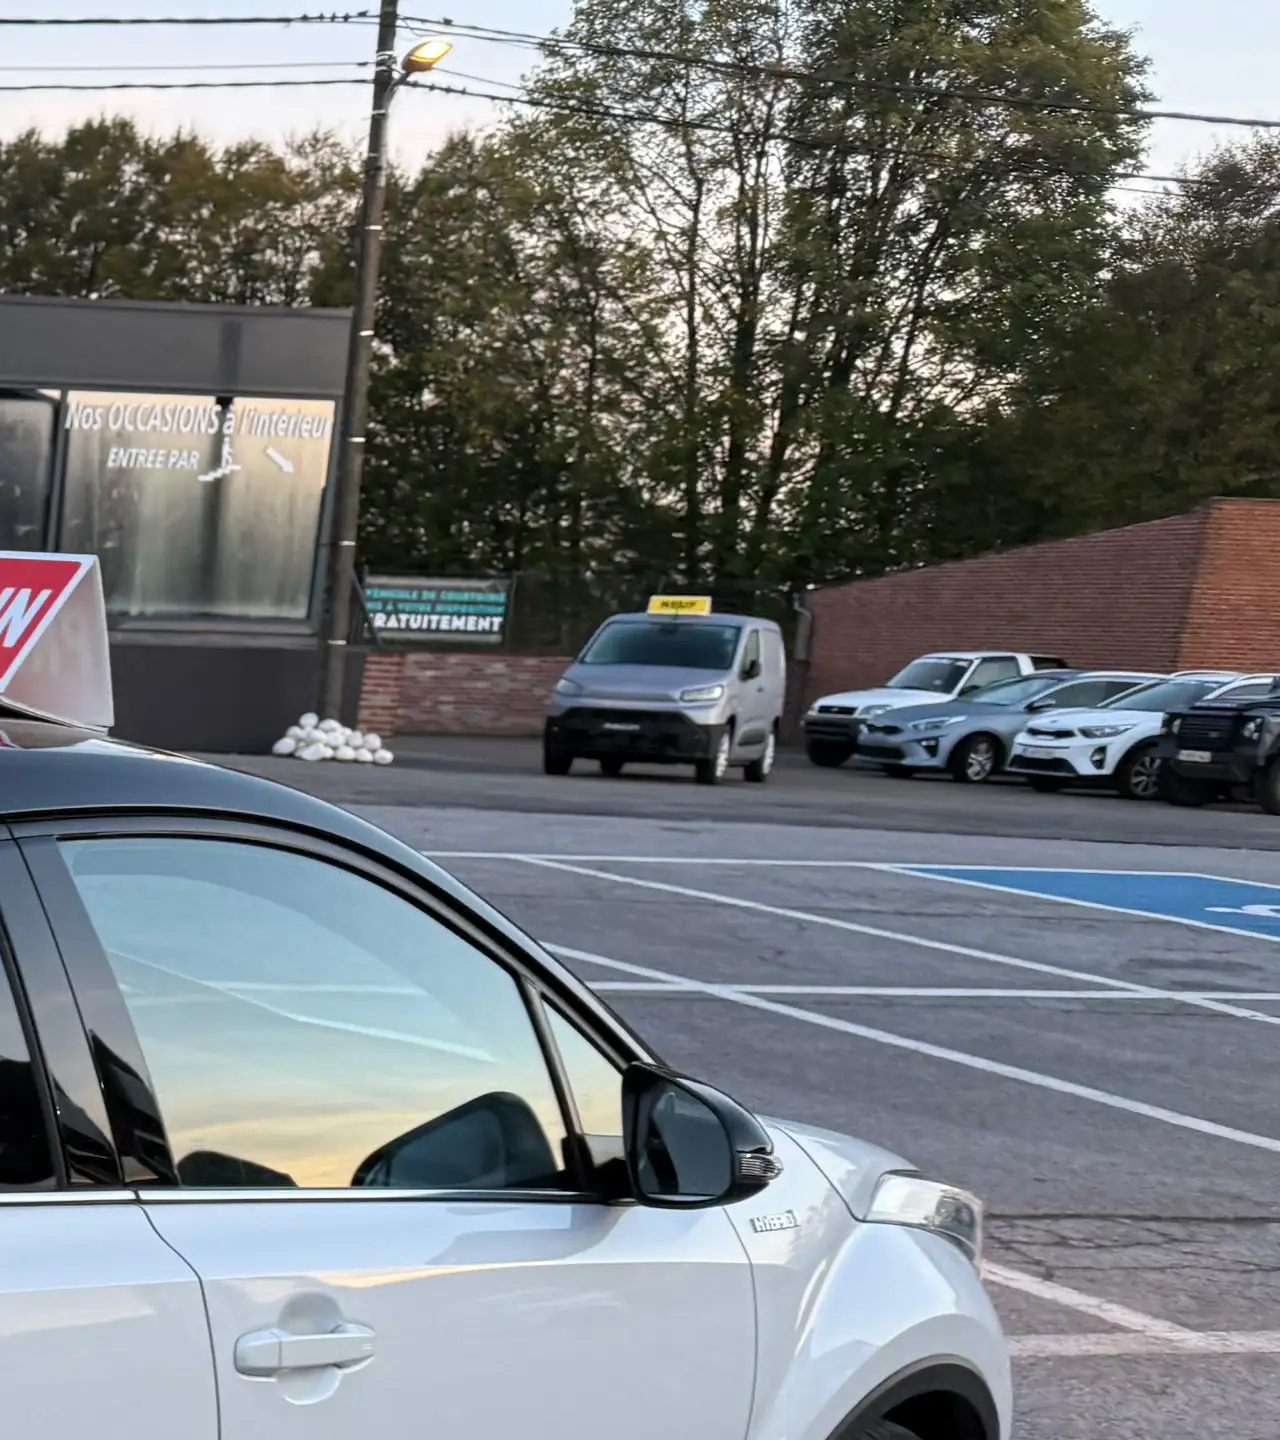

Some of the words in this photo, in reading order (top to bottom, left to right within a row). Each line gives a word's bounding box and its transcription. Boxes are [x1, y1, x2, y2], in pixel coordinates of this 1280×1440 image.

[64, 403, 101, 430] Nos
[108, 403, 221, 434] OCCASIONS
[167, 450, 200, 469] PAR
